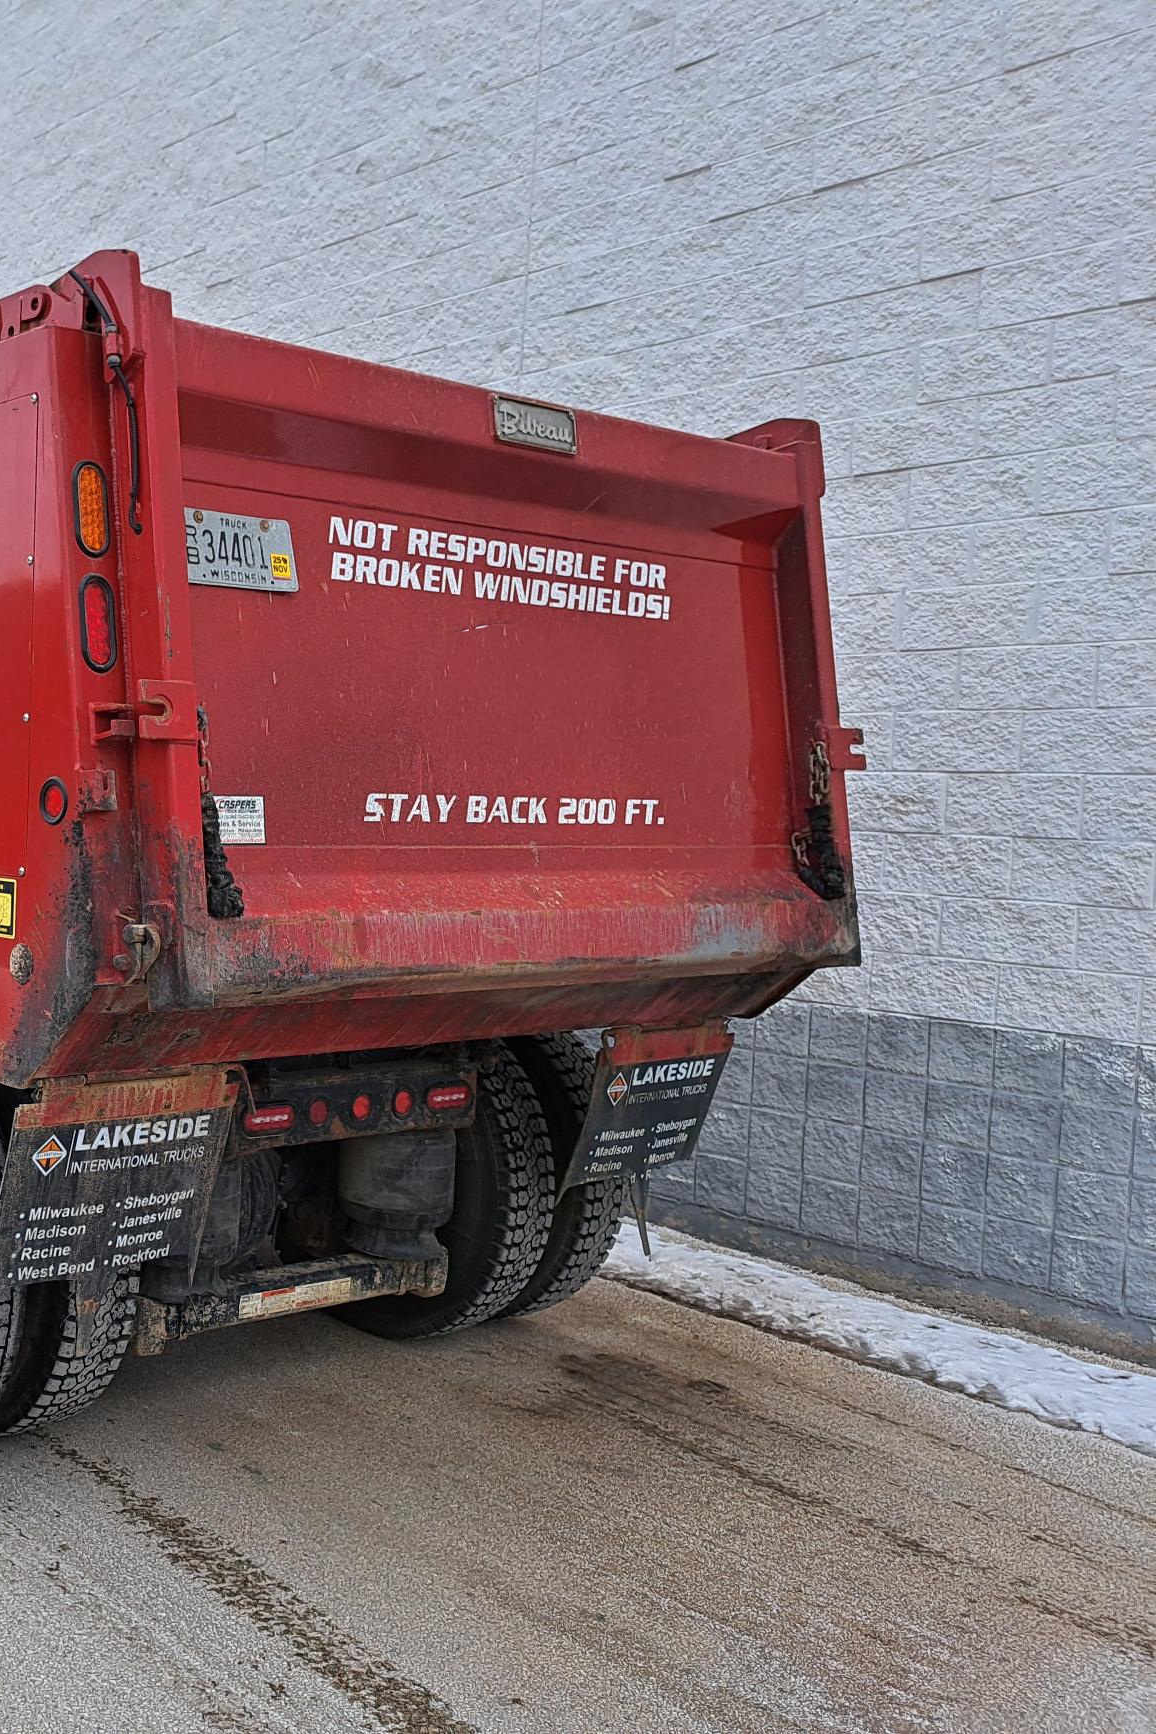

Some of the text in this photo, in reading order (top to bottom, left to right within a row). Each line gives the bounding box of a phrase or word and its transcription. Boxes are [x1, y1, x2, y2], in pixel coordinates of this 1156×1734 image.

[499, 401, 574, 442] Bibeau
[220, 517, 247, 529] TRUCK
[202, 529, 269, 570] 34401
[328, 516, 667, 590] NOT RESPONSIBLE FOR
[210, 568, 267, 584] WISCONSIN
[273, 564, 288, 573] NOV
[330, 551, 671, 621] BROKEN WINDSHIELDS!
[218, 800, 257, 809] CASPERS
[363, 793, 665, 825] STAY BACK 200 FT.
[631, 1058, 716, 1087] LAKESIDE
[628, 1087, 680, 1105] INTERNATIONAL
[681, 1082, 708, 1097] TRUCKS
[74, 1114, 211, 1152] LAKESIDE
[655, 1116, 697, 1134] Sheboygan
[599, 1127, 646, 1143] Milwaukee
[651, 1131, 688, 1150] Janesville
[70, 1145, 205, 1175] INTERNATIONAL TRUCKS
[594, 1144, 633, 1158] Madison
[647, 1150, 676, 1165] Monroe
[589, 1160, 623, 1173] Racine
[123, 1188, 195, 1211] Sheboygan
[28, 1203, 105, 1221] Milwaukee
[119, 1206, 183, 1230] Janesville
[24, 1224, 87, 1242] Madison
[115, 1229, 164, 1248] Monroe
[20, 1244, 72, 1262] Racine
[111, 1244, 171, 1268] Rockford
[17, 1258, 96, 1281] West Bend
